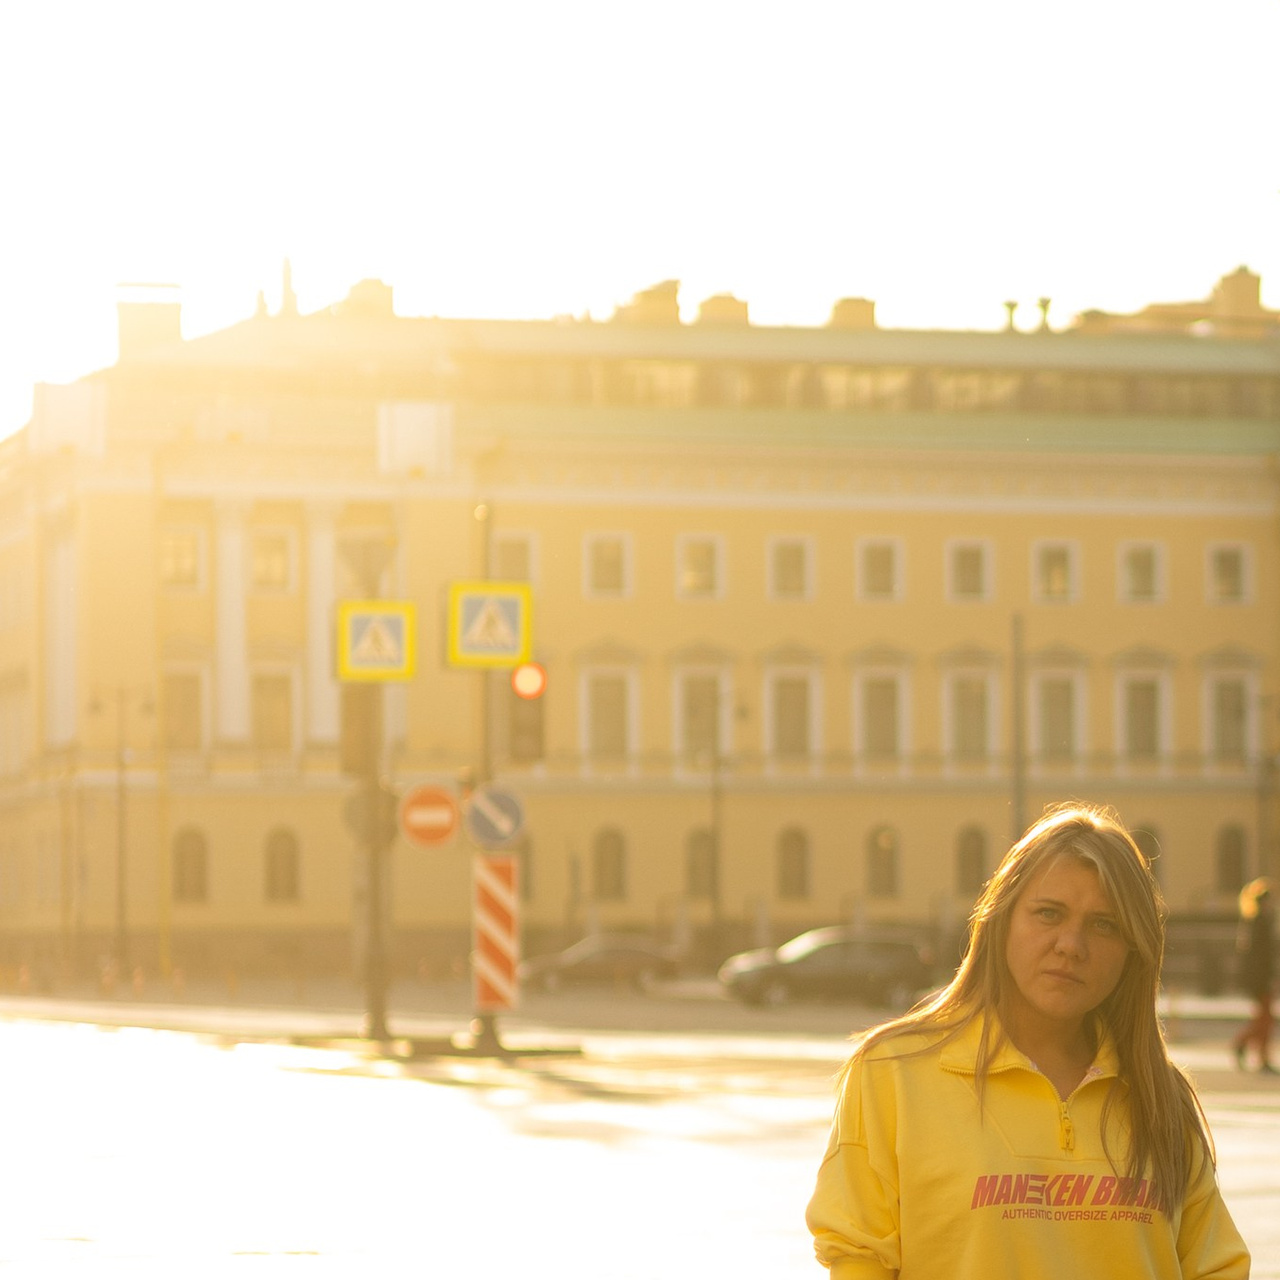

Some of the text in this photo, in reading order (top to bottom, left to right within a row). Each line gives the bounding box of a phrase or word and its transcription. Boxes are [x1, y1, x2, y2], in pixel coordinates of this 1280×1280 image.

[1090, 1176, 1164, 1211] BRAN
[1002, 1208, 1153, 1224] AUTHENTIC OVERSIZE APPAREL
